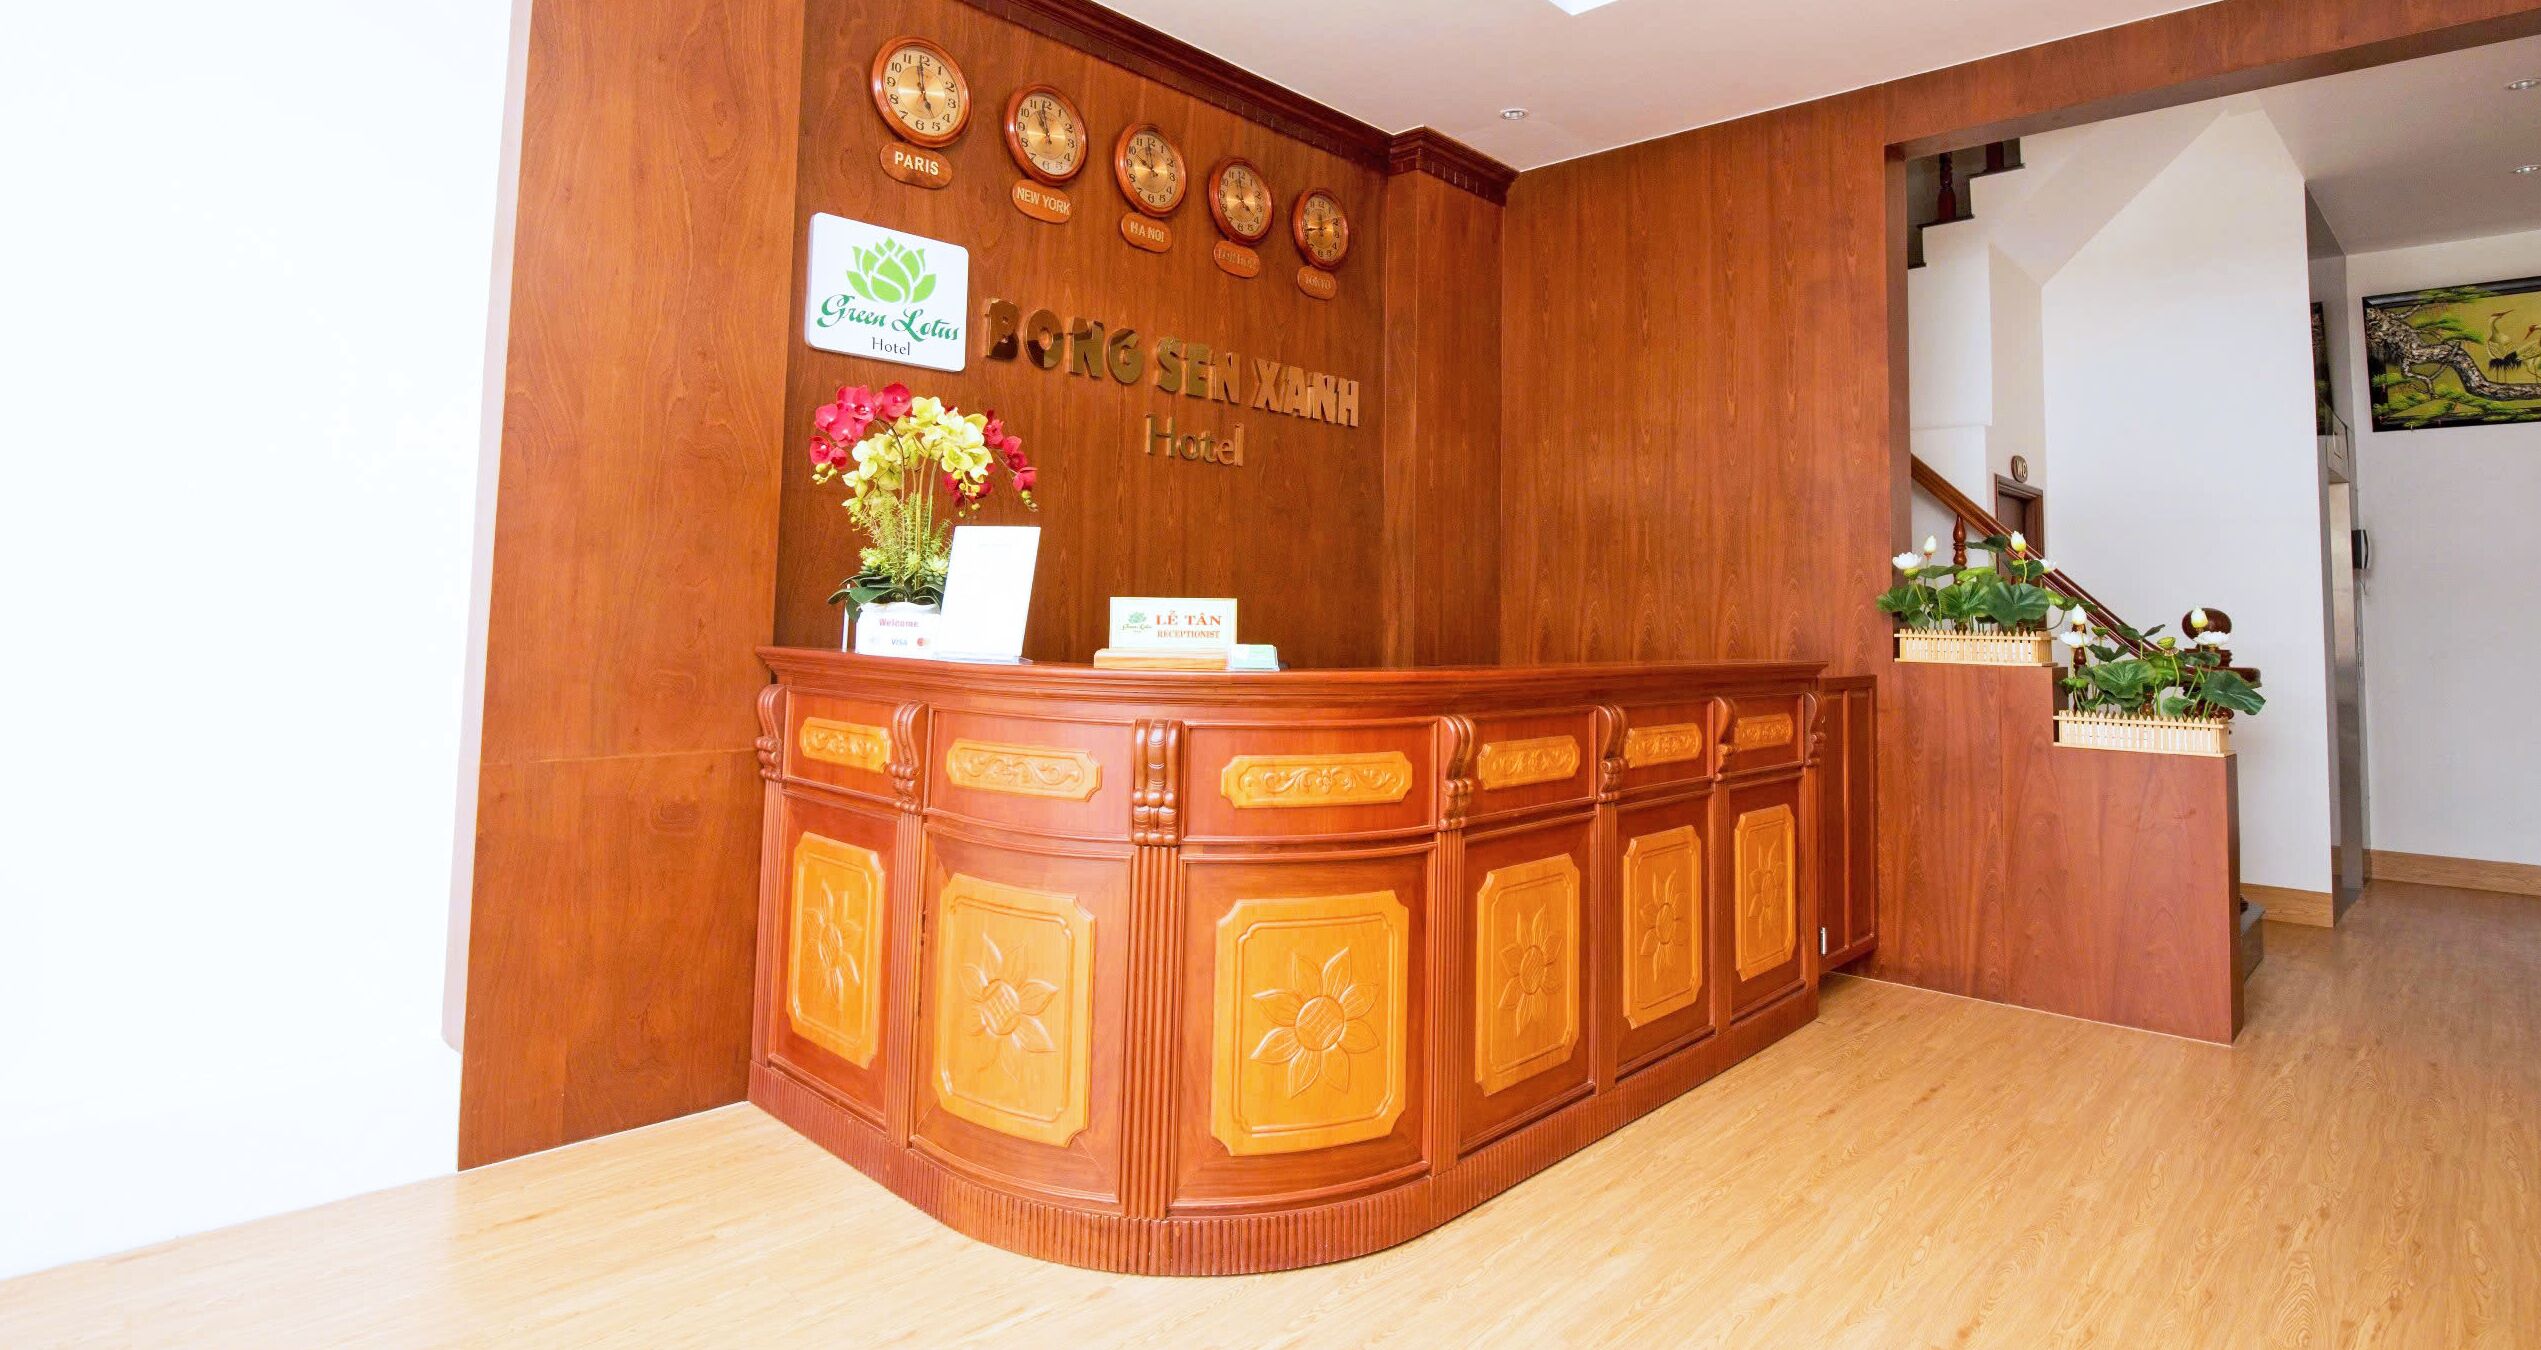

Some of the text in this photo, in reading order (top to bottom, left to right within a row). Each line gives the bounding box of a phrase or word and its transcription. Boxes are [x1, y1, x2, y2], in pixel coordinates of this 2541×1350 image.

[903, 54, 912, 65] 11
[919, 55, 931, 67] 12
[891, 62, 902, 73] 10
[937, 66, 942, 75] 1
[887, 77, 896, 87] 9
[945, 81, 955, 93] 2
[889, 94, 899, 104] 8
[947, 98, 957, 109] 3
[1029, 99, 1037, 110] 11
[899, 110, 908, 120] 7
[942, 113, 951, 123] 4
[1020, 108, 1030, 118] 10
[915, 120, 925, 131] 6
[932, 121, 941, 132] 5
[1017, 122, 1025, 131] 9
[1065, 123, 1073, 133] 2
[1021, 138, 1029, 148] 8
[1067, 139, 1075, 149] 3
[1136, 138, 1143, 147] 11
[1128, 145, 1137, 155] 10
[1029, 153, 1036, 161] 7
[1063, 153, 1071, 162] 4
[894, 150, 939, 176] PARIS
[1042, 160, 1050, 170] 6
[1055, 162, 1063, 171] 5
[1126, 159, 1133, 168] 9
[1167, 158, 1174, 167] 2
[1129, 174, 1136, 183] 8
[1169, 172, 1176, 182] 3
[1166, 186, 1172, 195] 4
[1017, 187, 1071, 215] NEW YORK
[1147, 193, 1155, 203] 6
[1159, 194, 1166, 203] 5
[1130, 221, 1164, 243] HA NOI
[816, 294, 960, 342] Green Lotus
[872, 337, 911, 356] Hotel
[985, 298, 1360, 427] BONG SEN XANH
[1145, 412, 1244, 467] Hotel
[2015, 459, 2027, 478] WC
[879, 618, 920, 628] Welcome
[1184, 612, 1223, 626] TÂN
[1157, 630, 1221, 639] RECEPTIONIST
[891, 638, 908, 647] VISA
